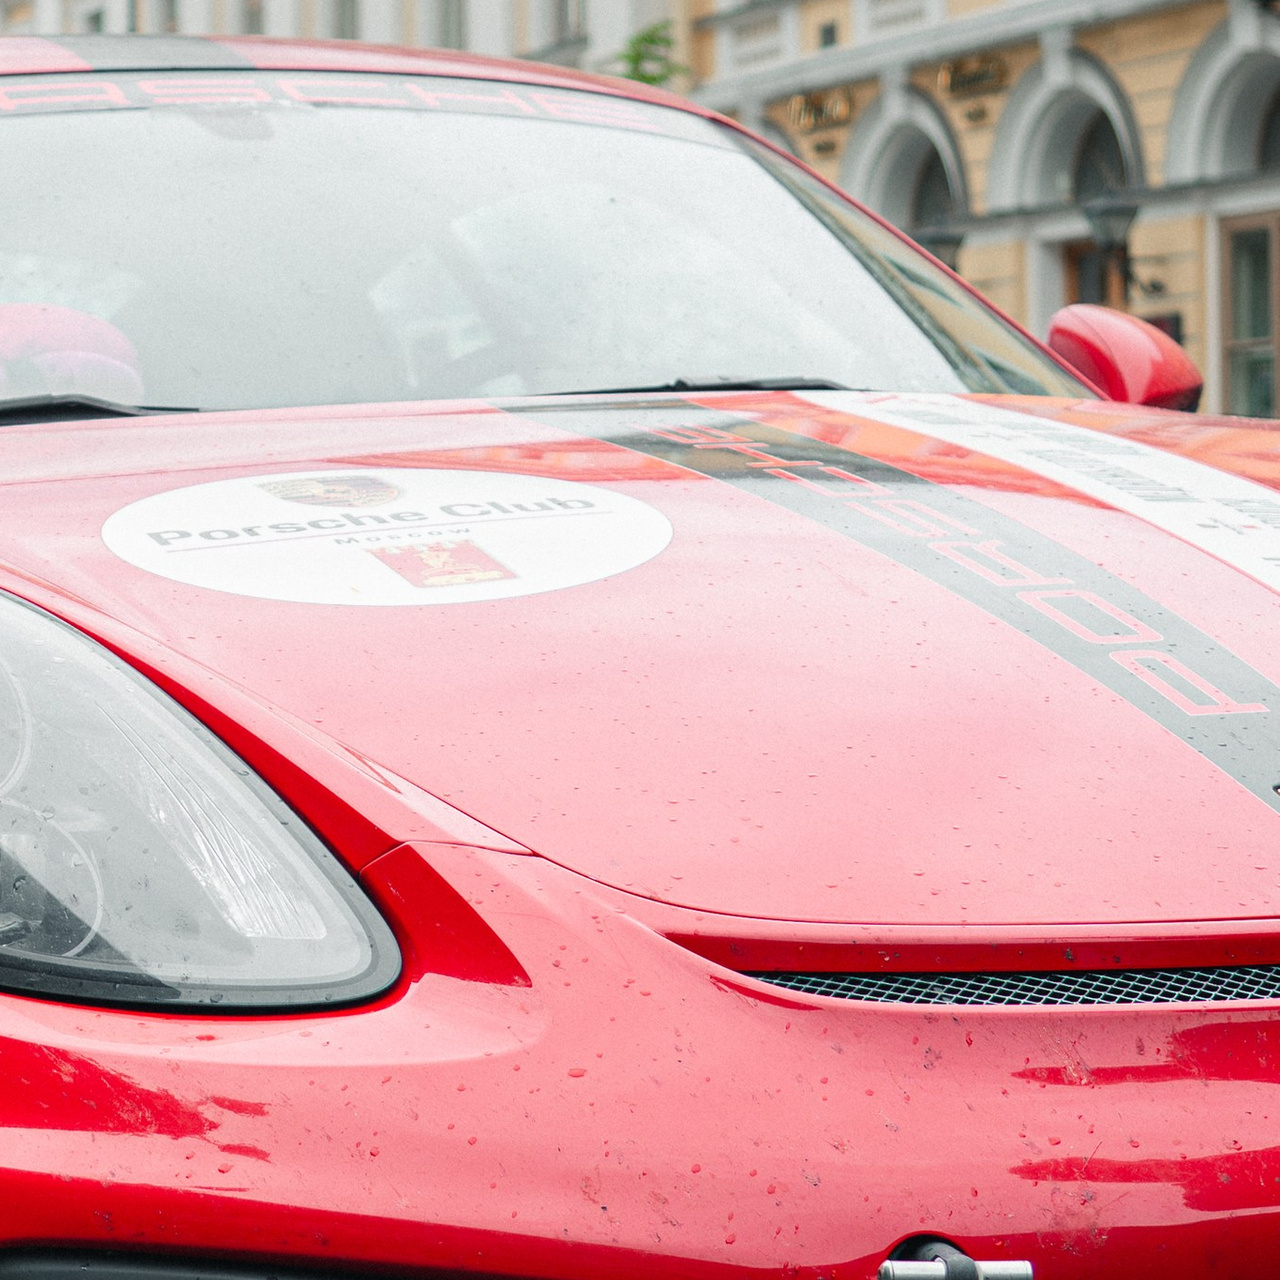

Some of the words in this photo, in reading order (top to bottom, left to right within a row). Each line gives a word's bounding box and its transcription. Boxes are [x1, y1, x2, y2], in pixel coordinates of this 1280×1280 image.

[146, 508, 429, 547] Porsche
[438, 494, 597, 519] Club
[628, 423, 1270, 716] PORSCHE
